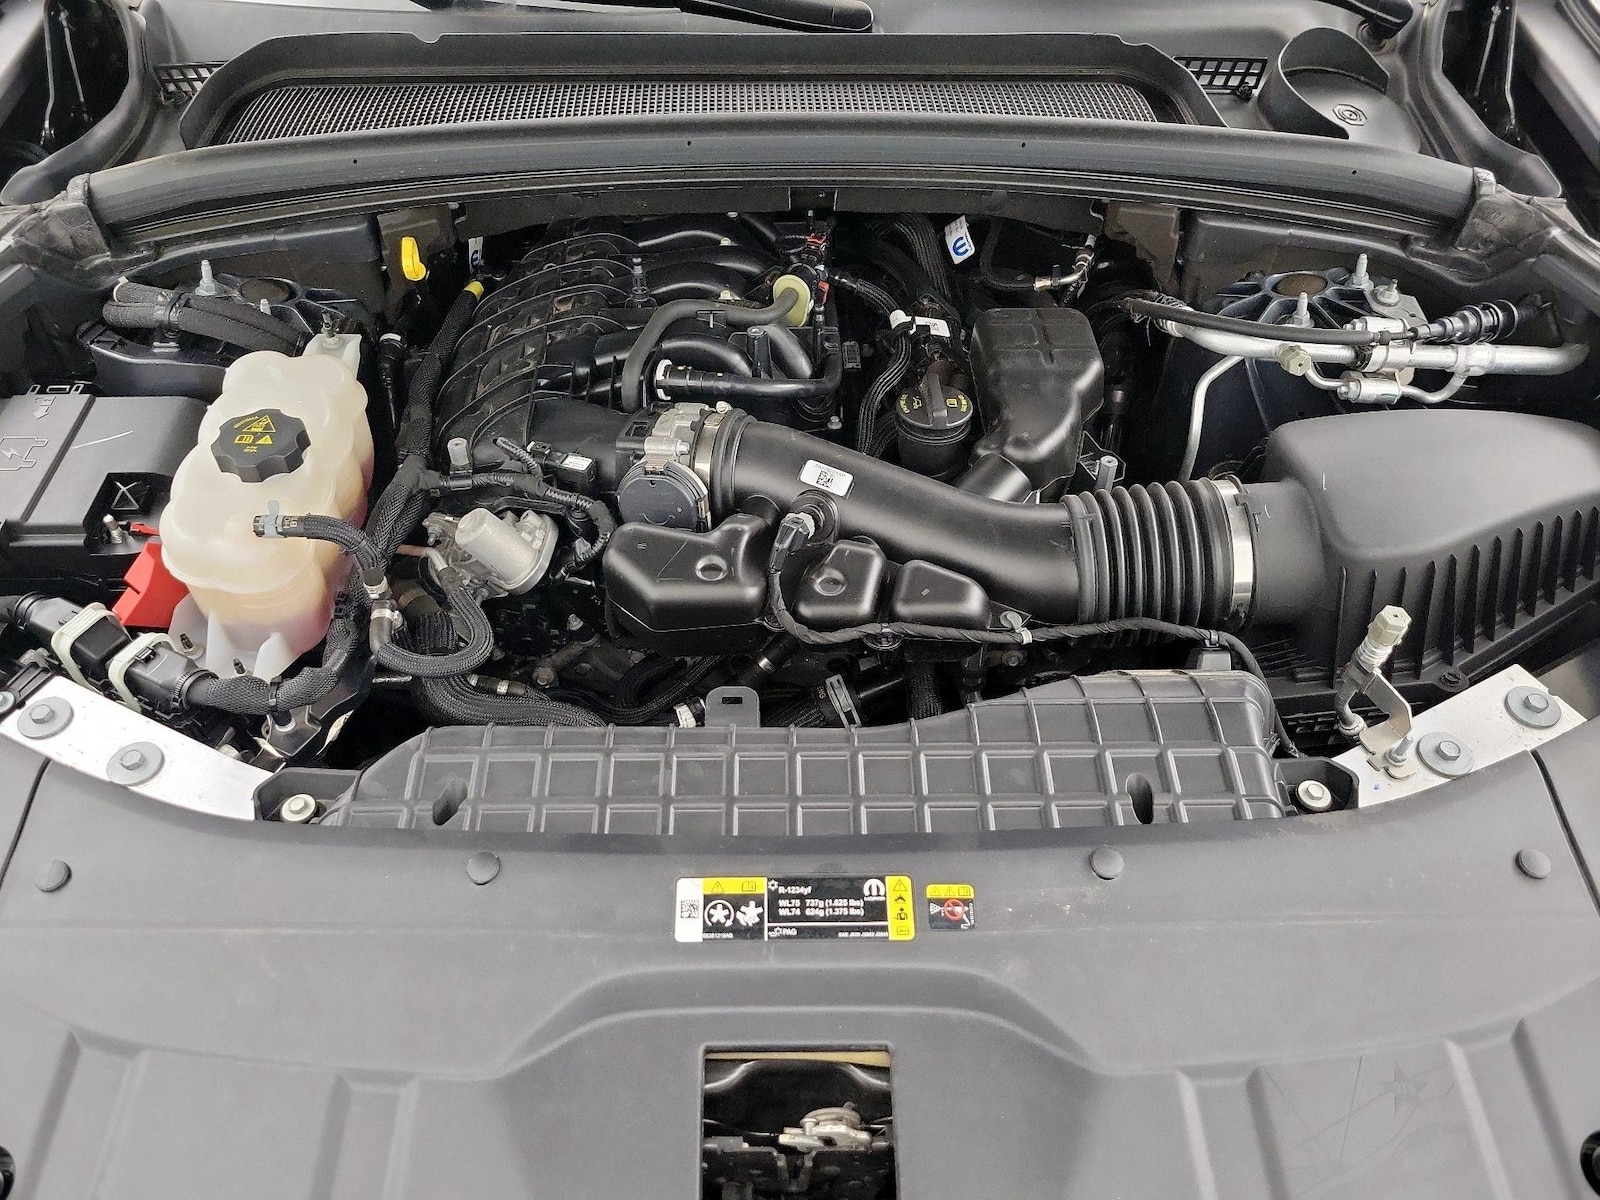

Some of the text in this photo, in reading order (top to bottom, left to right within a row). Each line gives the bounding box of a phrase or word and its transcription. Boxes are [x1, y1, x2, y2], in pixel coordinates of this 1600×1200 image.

[778, 886, 812, 895] R-1234yf
[778, 899, 864, 908] WL75 737g (1.625 lbs)
[778, 908, 865, 917] WL74 624g (1.375 lbs)
[783, 928, 798, 936] PAG
